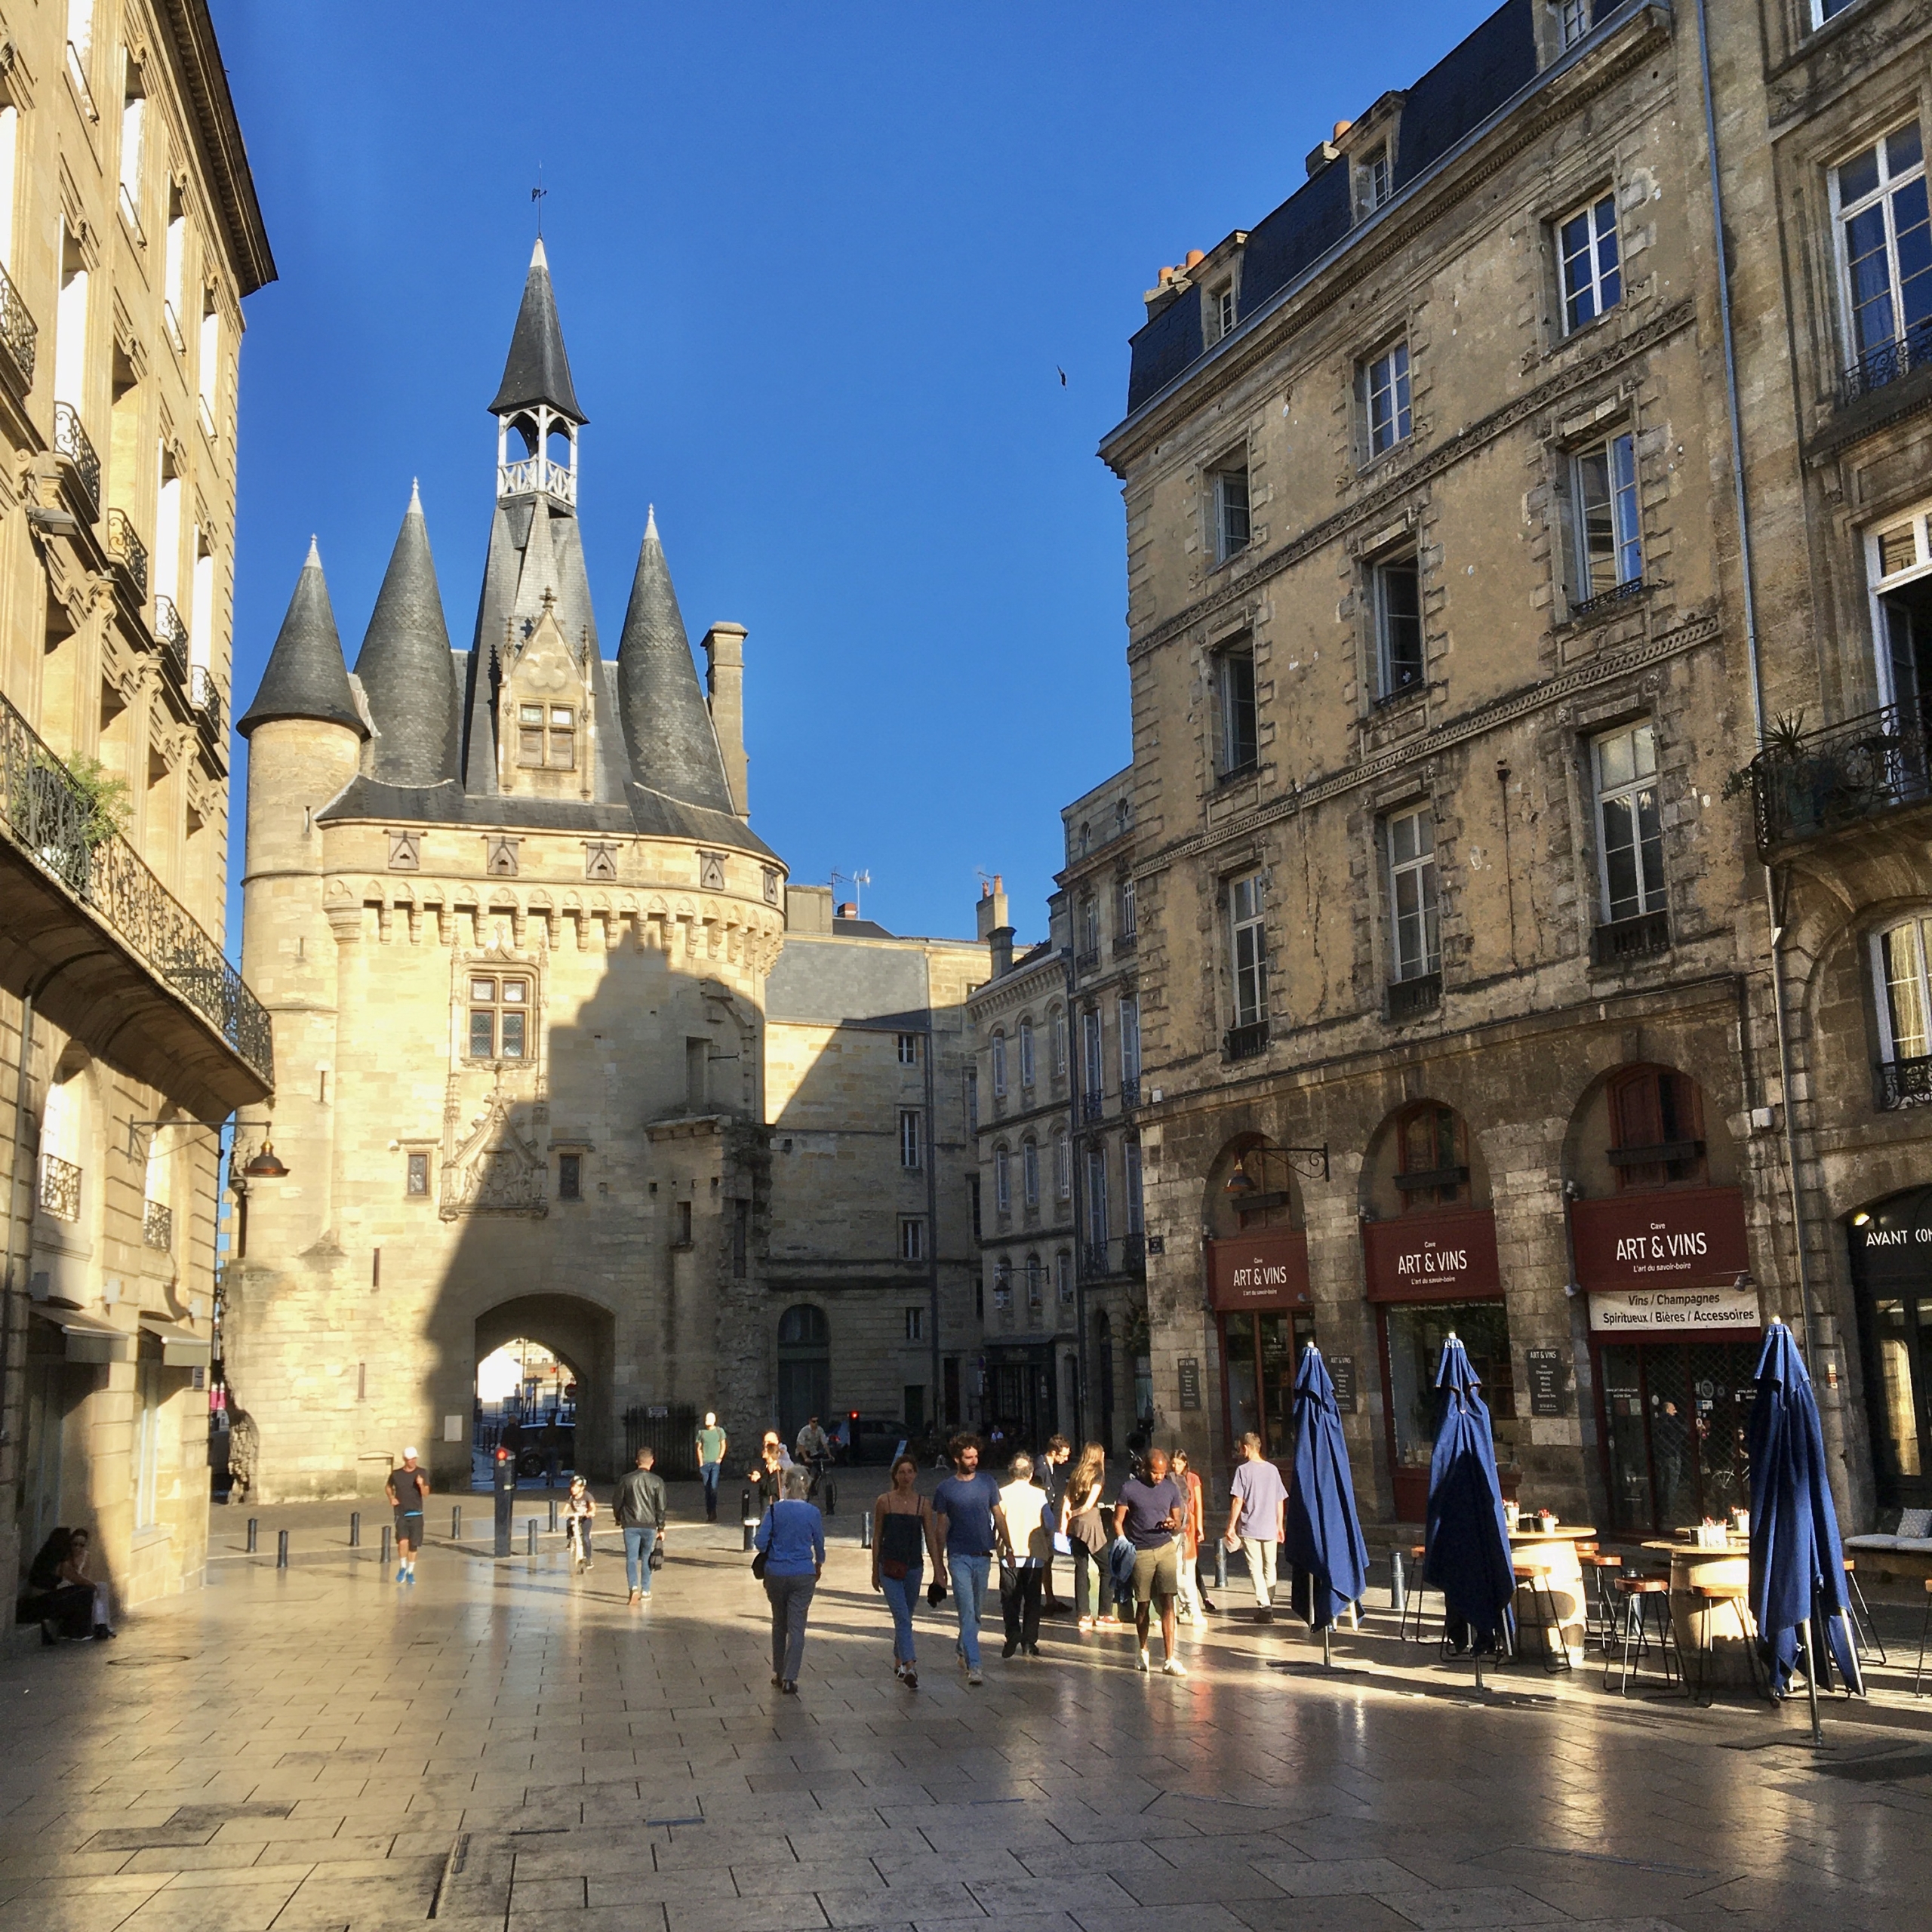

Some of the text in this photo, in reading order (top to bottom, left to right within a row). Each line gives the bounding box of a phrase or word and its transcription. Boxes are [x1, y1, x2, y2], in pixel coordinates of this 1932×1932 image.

[1617, 1232, 1707, 1261] ART & VINS
[1866, 1229, 1908, 1247] AVANT
[1398, 1250, 1467, 1275] ART & VINS
[1633, 1262, 1691, 1273] L'art du savoir-boire
[1233, 1266, 1287, 1287] ART & VINS
[1628, 1294, 1720, 1307] Vins / Champagnes
[1603, 1312, 1647, 1326] Spiritueux
[1655, 1311, 1685, 1323] Bières
[1694, 1309, 1755, 1322] Accessoires
[1545, 1350, 1557, 1359] VINS
